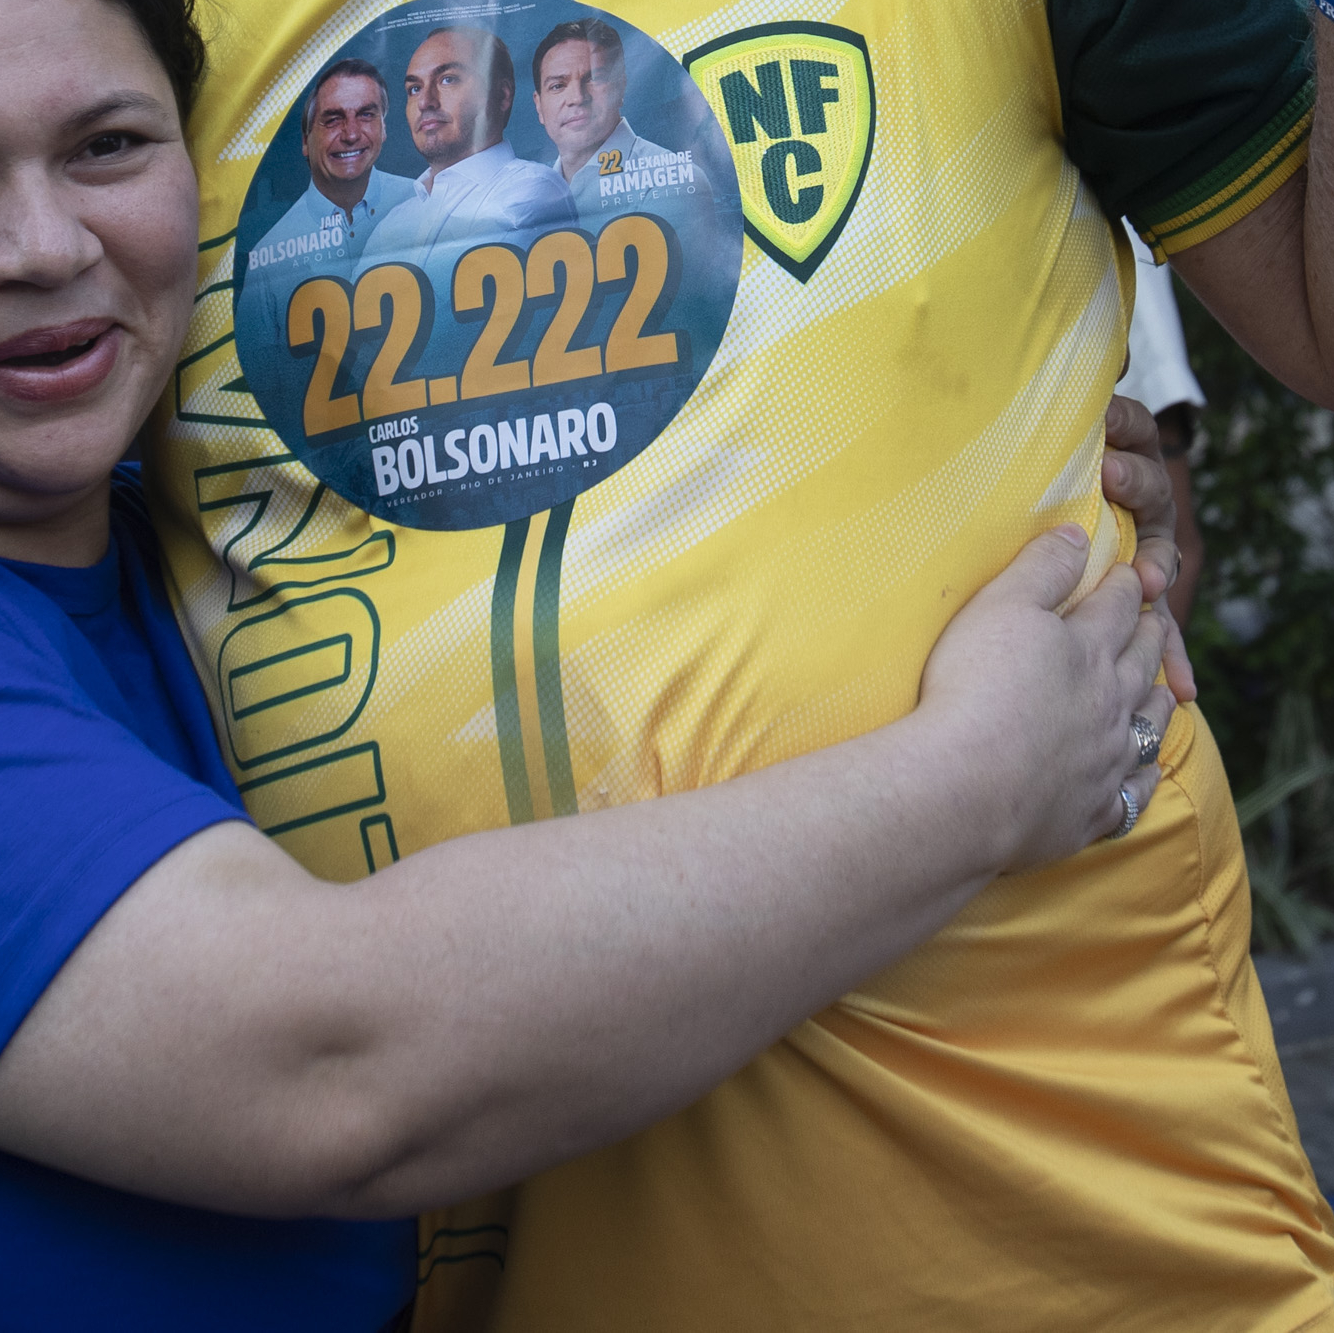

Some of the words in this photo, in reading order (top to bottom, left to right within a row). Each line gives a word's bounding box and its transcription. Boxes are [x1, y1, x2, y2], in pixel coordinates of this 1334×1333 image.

[598, 149, 622, 176] 22
[624, 150, 693, 172] ALEXANDRE
[599, 164, 694, 197] RAMAGEM
[601, 186, 696, 208] PREFEITO
[319, 213, 343, 230] JAIR
[249, 227, 343, 270] BOLSONARO
[292, 248, 345, 268] APOIO
[286, 214, 681, 439] 22.222
[368, 415, 419, 443] CARLOS
[372, 402, 617, 496] BOLSONARO
[387, 488, 443, 508] VEREADOR
[460, 480, 481, 491] RIO
[488, 476, 503, 485] DE
[510, 465, 564, 481] JANEIRO
[583, 459, 597, 468] RJ
